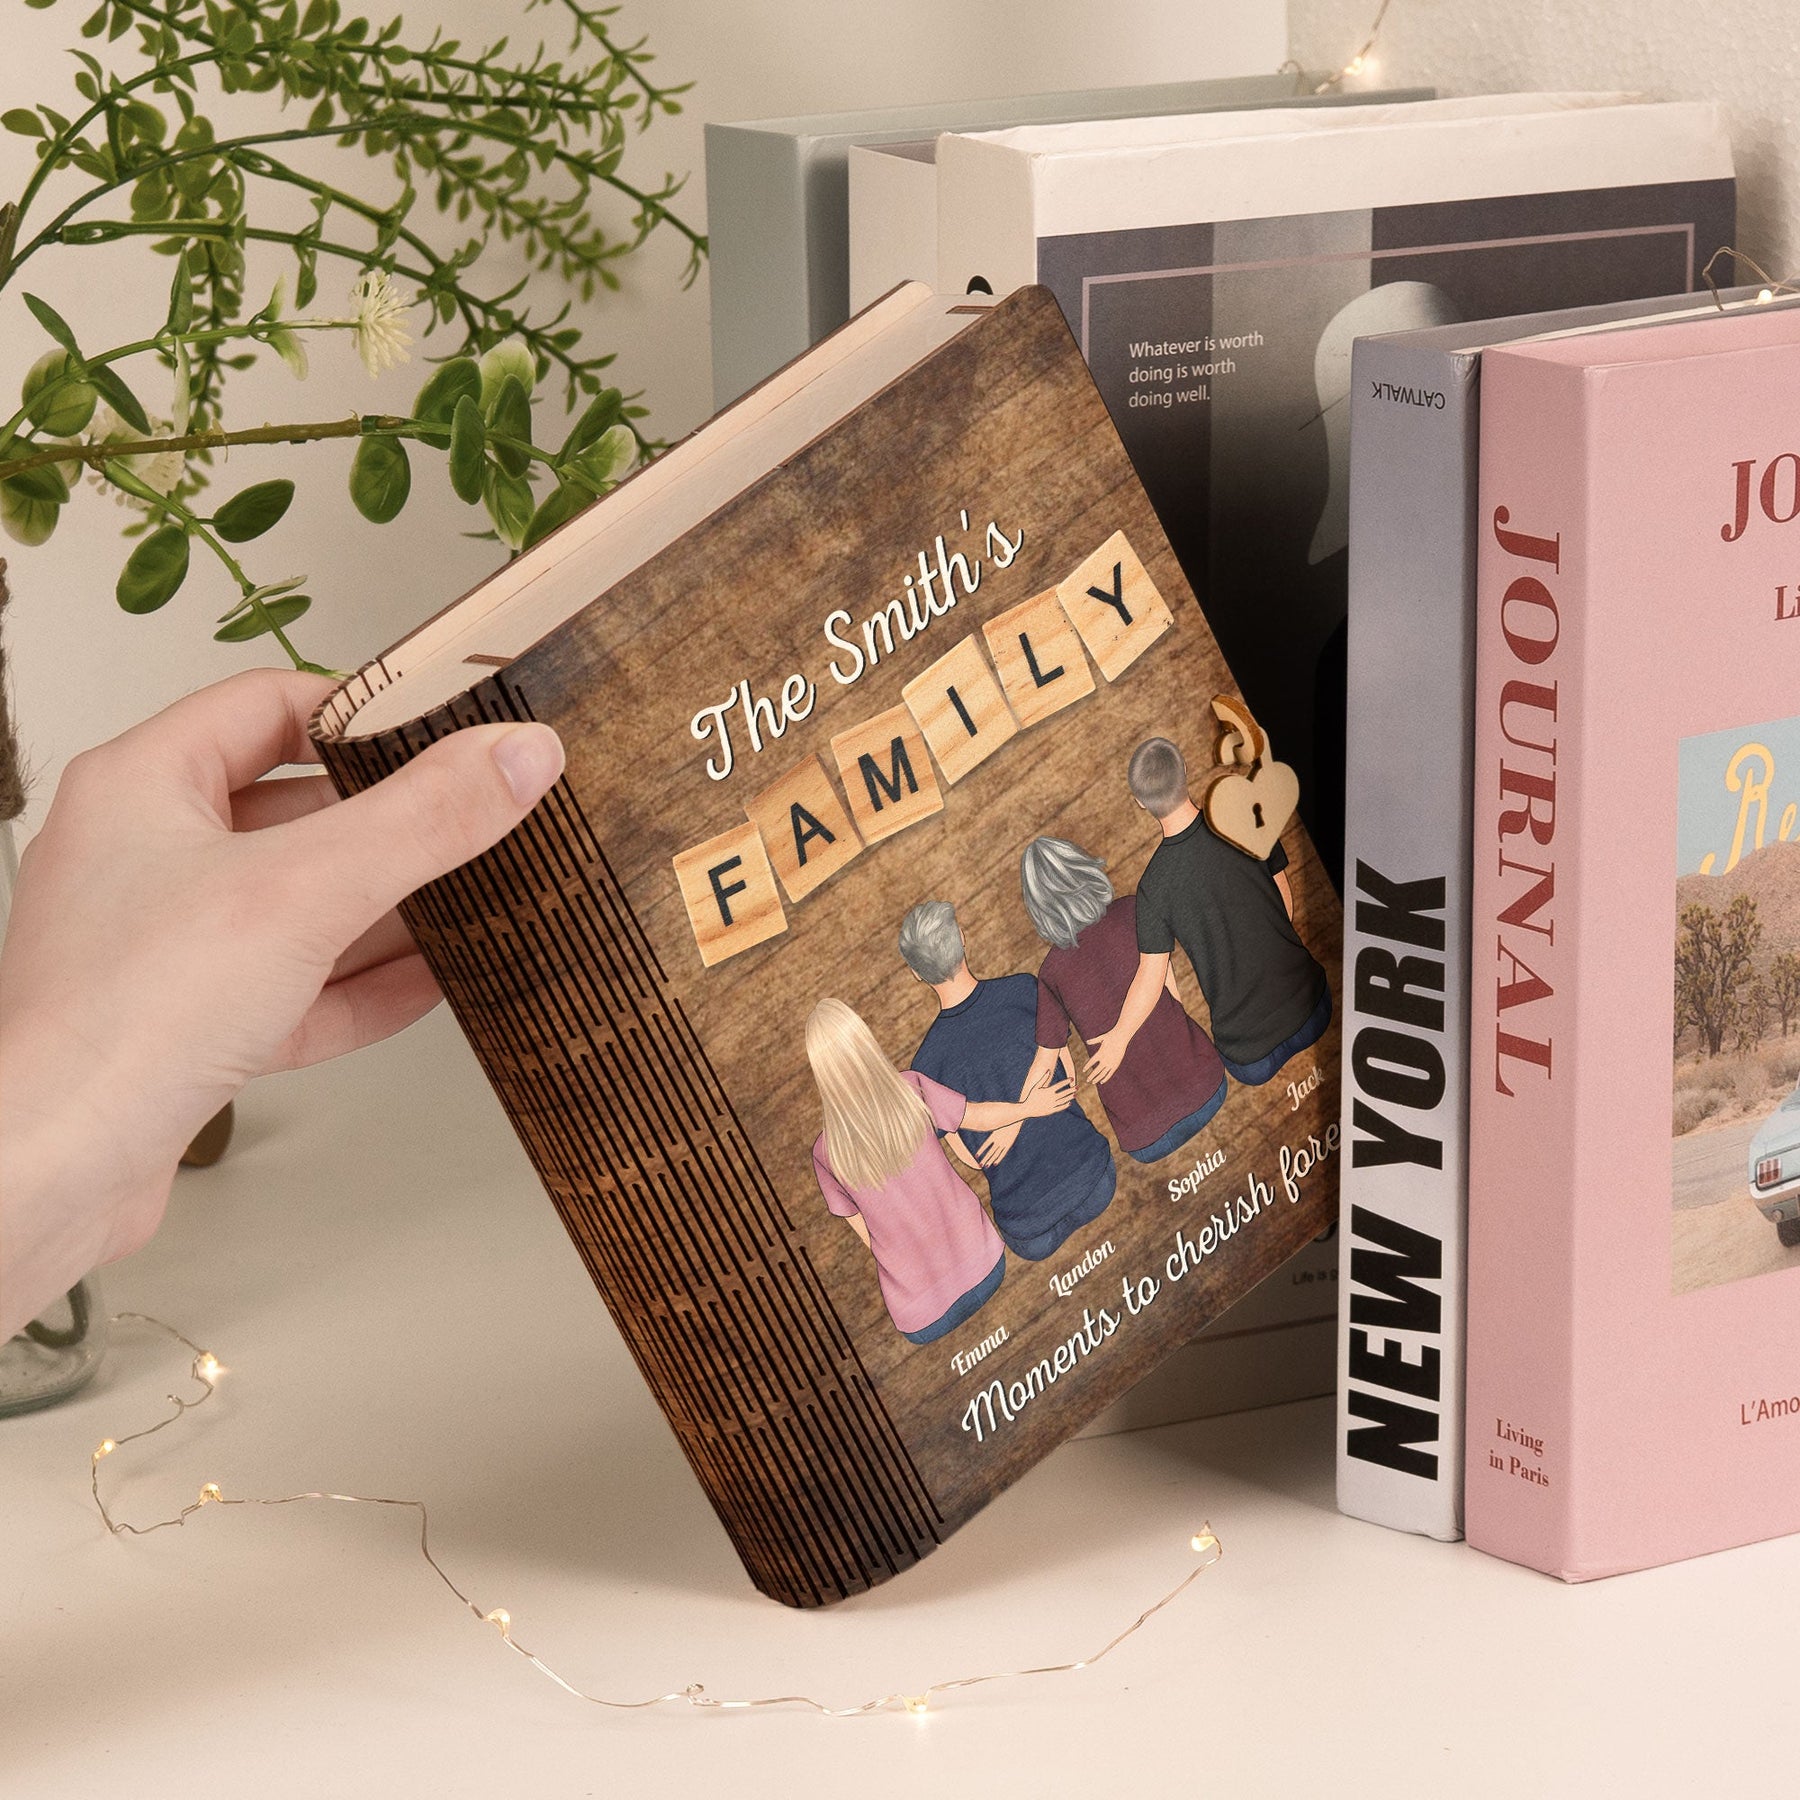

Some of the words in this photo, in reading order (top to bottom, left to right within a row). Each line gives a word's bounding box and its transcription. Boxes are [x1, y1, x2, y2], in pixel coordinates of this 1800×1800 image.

[1128, 366, 1173, 384] doing
[1176, 363, 1188, 379] is
[1191, 357, 1237, 377] worth
[1129, 340, 1202, 359] Whatever
[1204, 336, 1216, 351] is
[1219, 330, 1265, 350] worth
[1128, 391, 1173, 409] doing
[1175, 384, 1211, 404] well.
[1371, 381, 1446, 410] CATWALK
[690, 673, 818, 780] The
[823, 509, 1024, 685] Smith's
[707, 561, 1134, 927] FAMILY
[1493, 505, 1560, 1098] JOURNAL
[1351, 857, 1446, 1170] YORK
[1286, 1065, 1325, 1111] Jack
[1167, 1148, 1227, 1202] Sophia
[1049, 1239, 1116, 1297] Landon
[961, 1307, 1122, 1442] Moments
[1121, 1272, 1161, 1315] to
[1164, 1172, 1275, 1282] cherish
[950, 1325, 1010, 1376] Emma
[1346, 1203, 1442, 1481] NEW
[1496, 1418, 1545, 1457] Living
[1489, 1449, 1504, 1472] in
[1509, 1455, 1550, 1488] Paris
